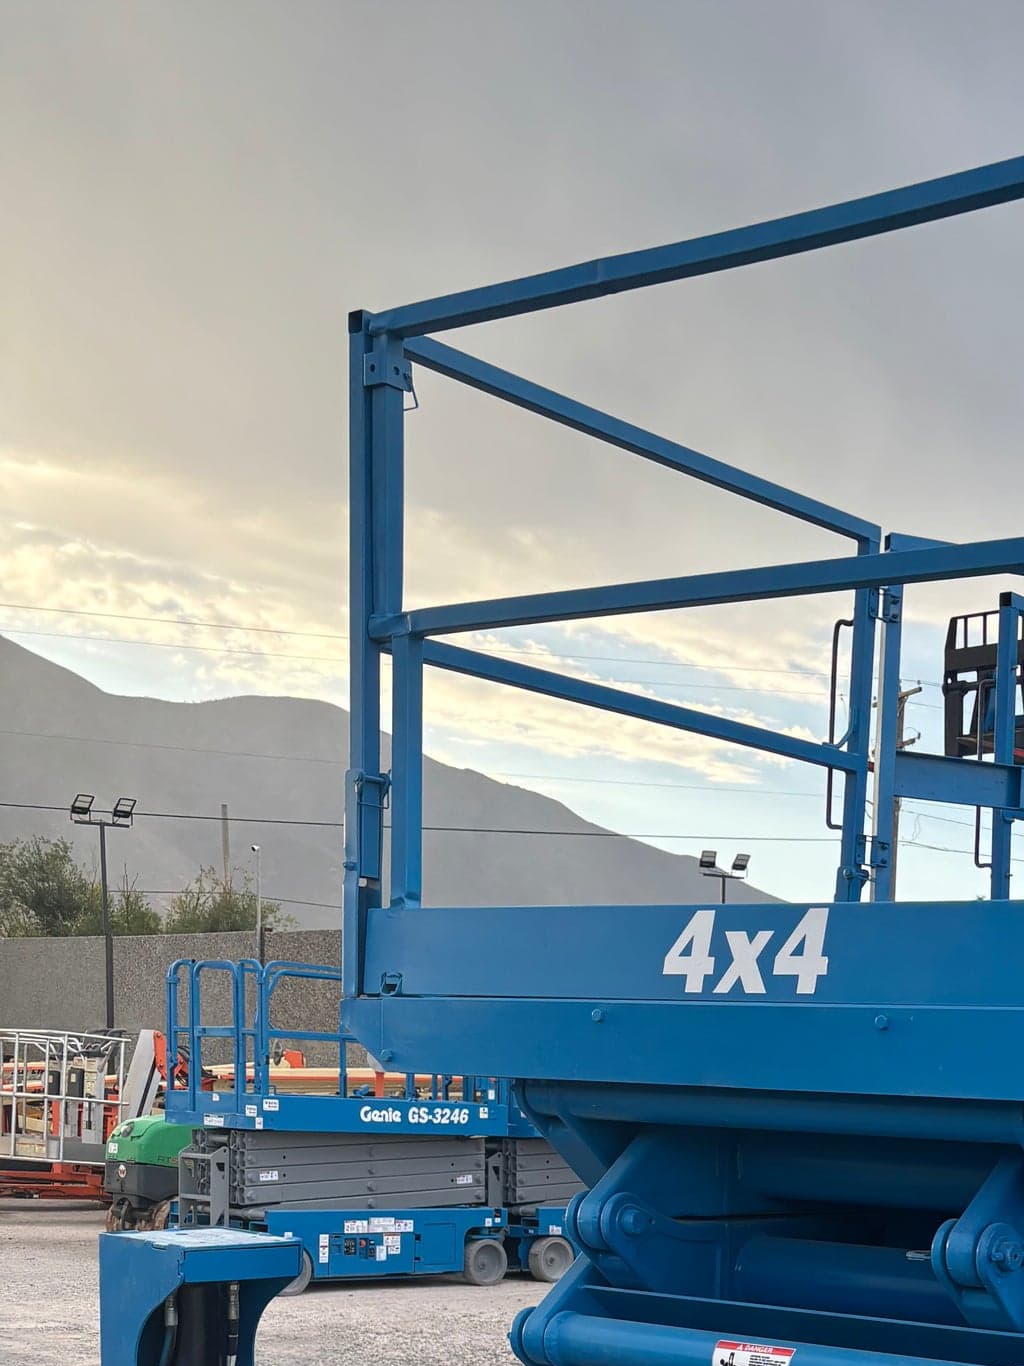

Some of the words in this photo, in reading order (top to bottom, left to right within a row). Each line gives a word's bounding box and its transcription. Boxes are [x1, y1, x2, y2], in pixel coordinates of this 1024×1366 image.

[663, 908, 829, 994] 4x4
[360, 1105, 402, 1122] Genie
[408, 1107, 469, 1124] GS-3246
[745, 1344, 774, 1354] DANGER
